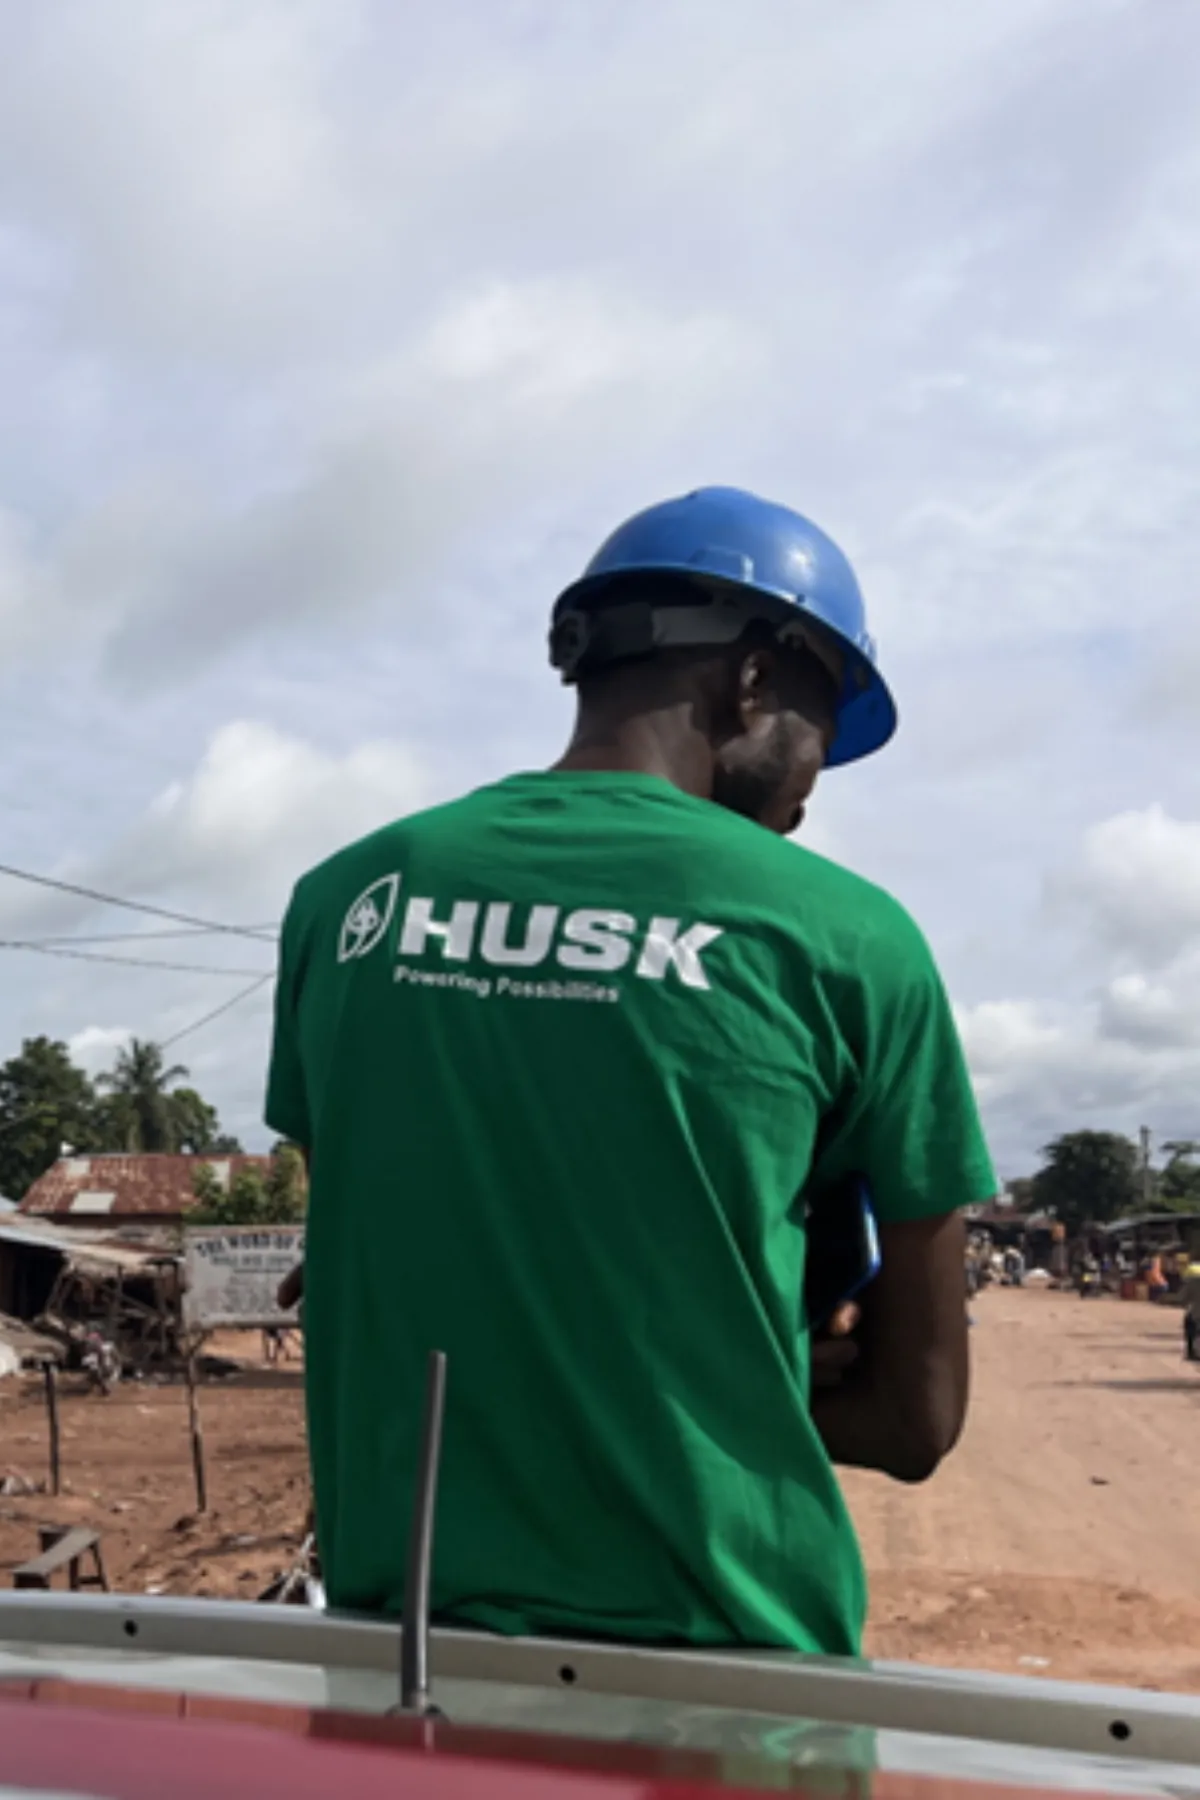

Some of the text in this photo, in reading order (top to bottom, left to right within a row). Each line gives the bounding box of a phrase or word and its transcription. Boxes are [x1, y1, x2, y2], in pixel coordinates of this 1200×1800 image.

[399, 897, 723, 989] HUSK
[393, 965, 619, 1002] Powering Possibilities
